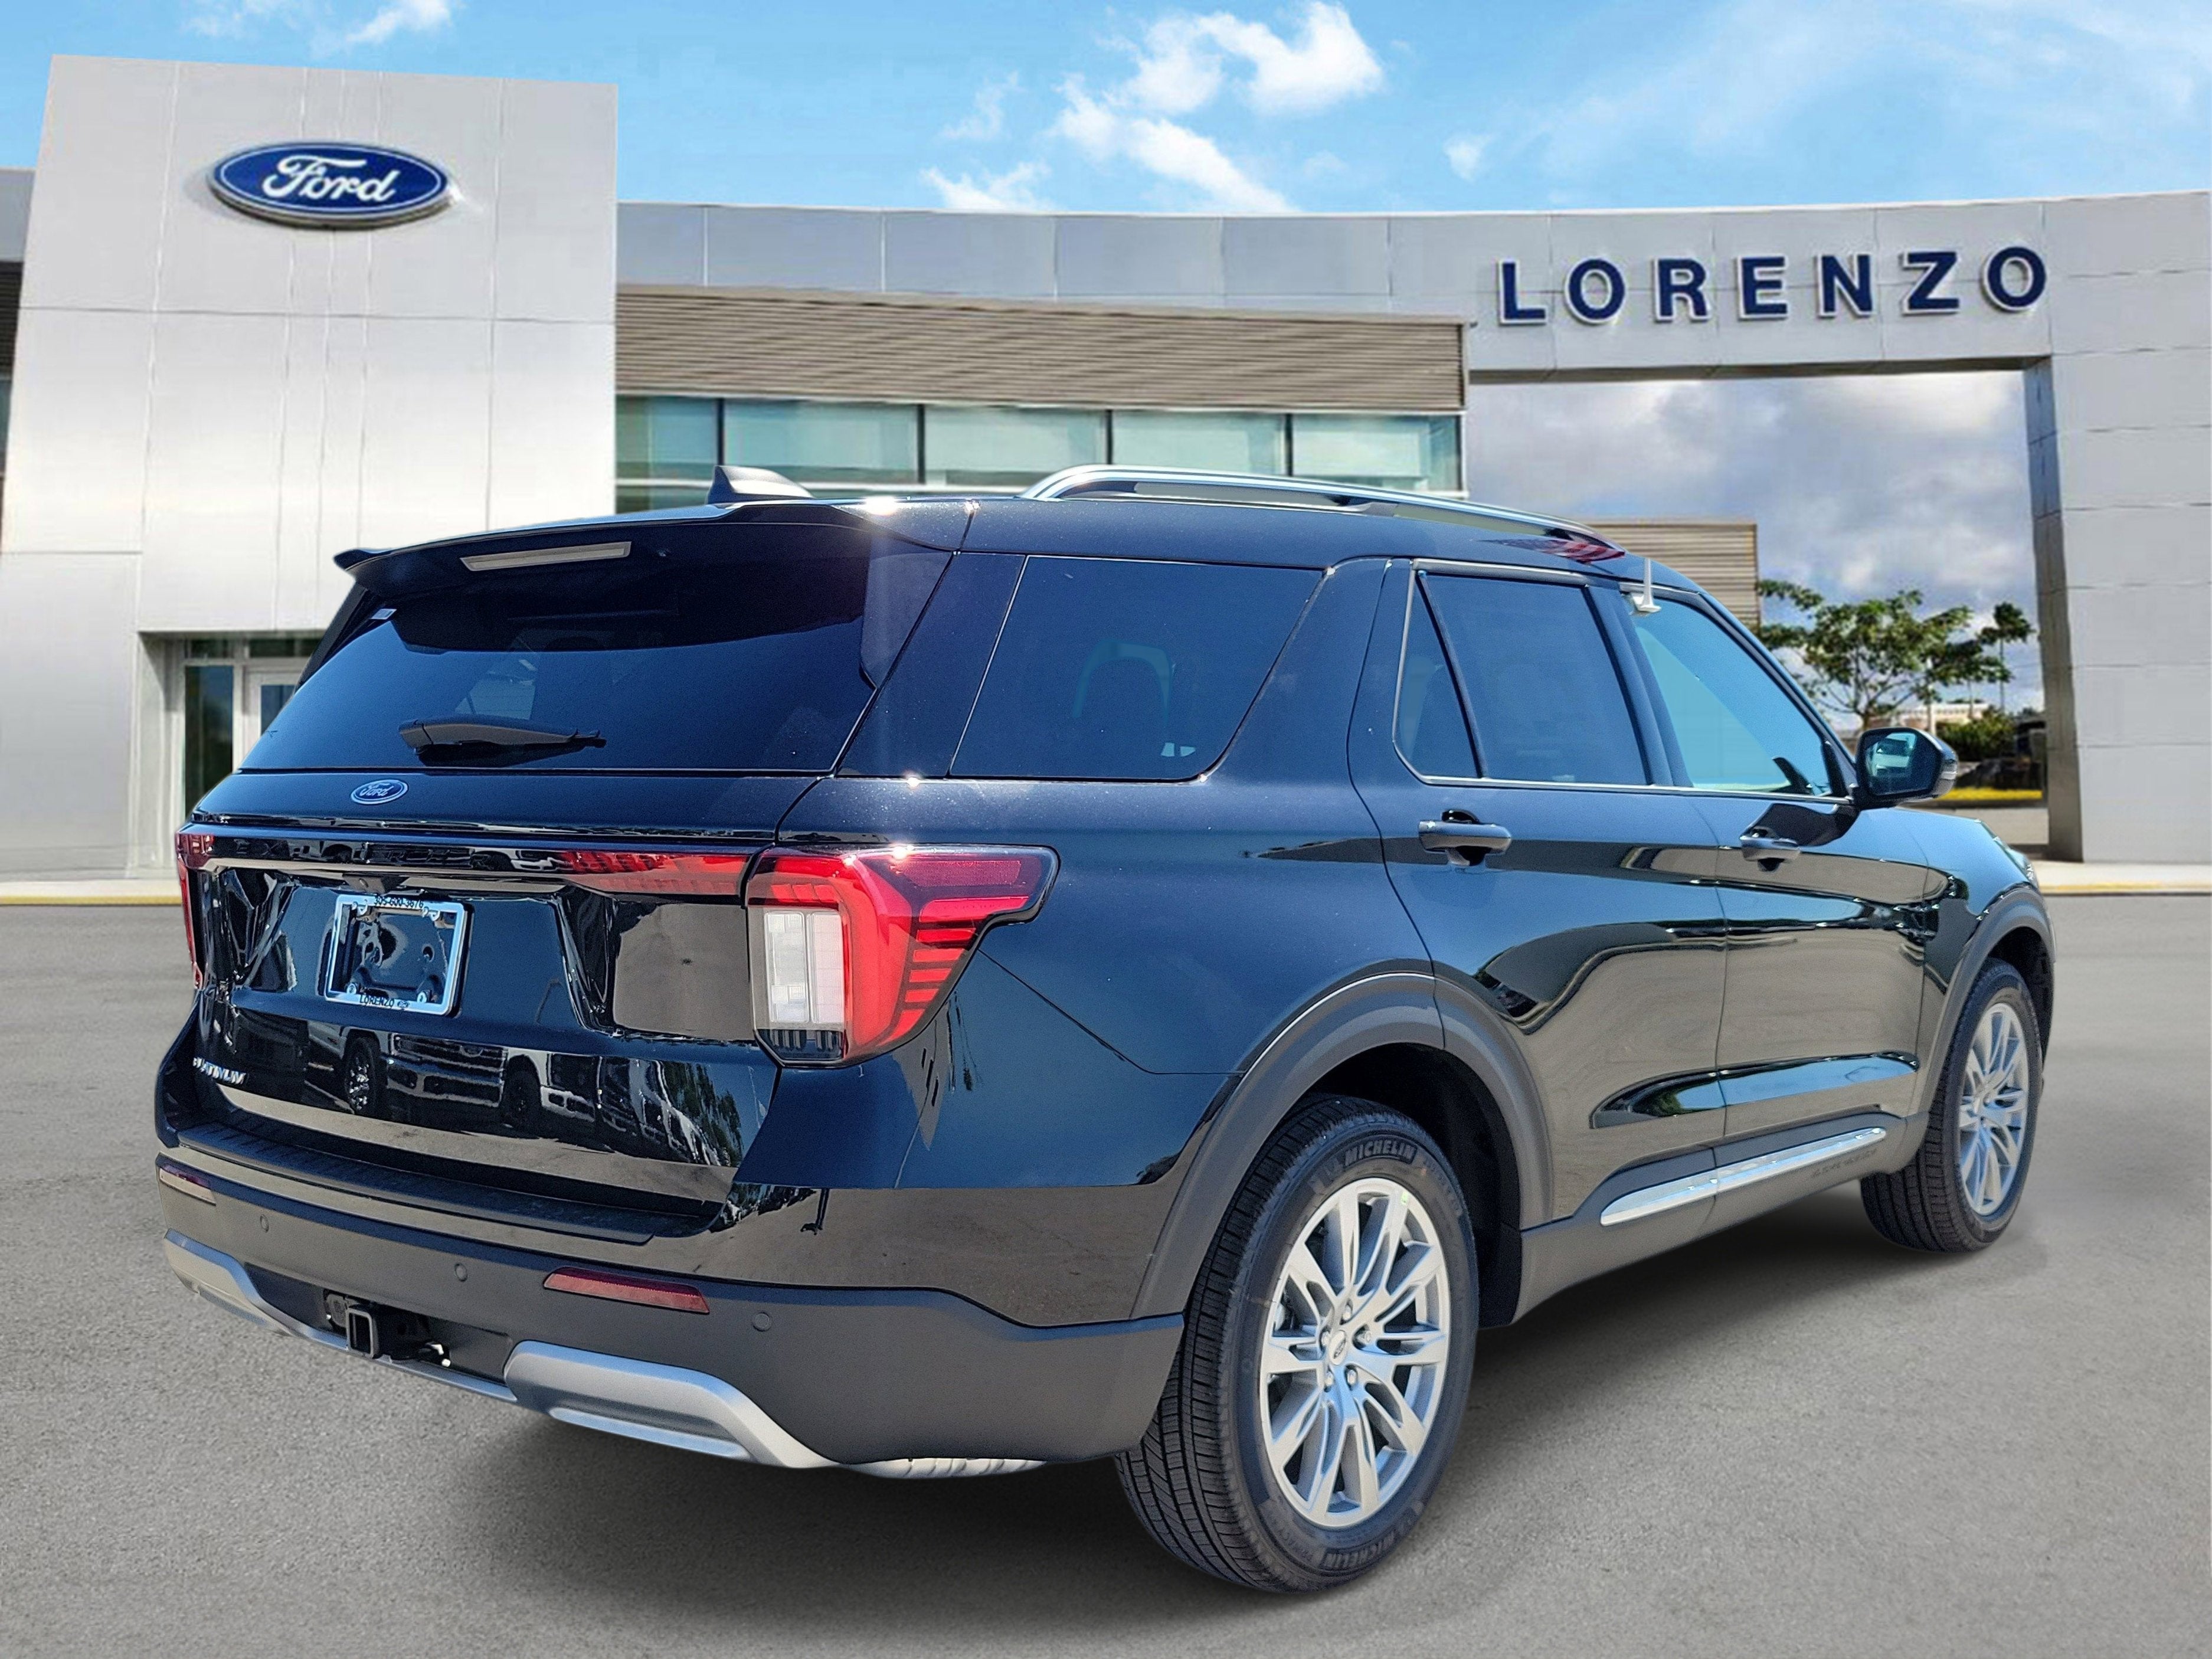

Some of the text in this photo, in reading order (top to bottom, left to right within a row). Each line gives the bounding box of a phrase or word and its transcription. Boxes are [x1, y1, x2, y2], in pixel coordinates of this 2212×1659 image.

[263, 154, 401, 202] Ford
[1498, 245, 2047, 324] LORENZO
[359, 782, 395, 797] Ford
[359, 994, 395, 1007] LORENZO
[1344, 1139, 1416, 1166] MICHELIN
